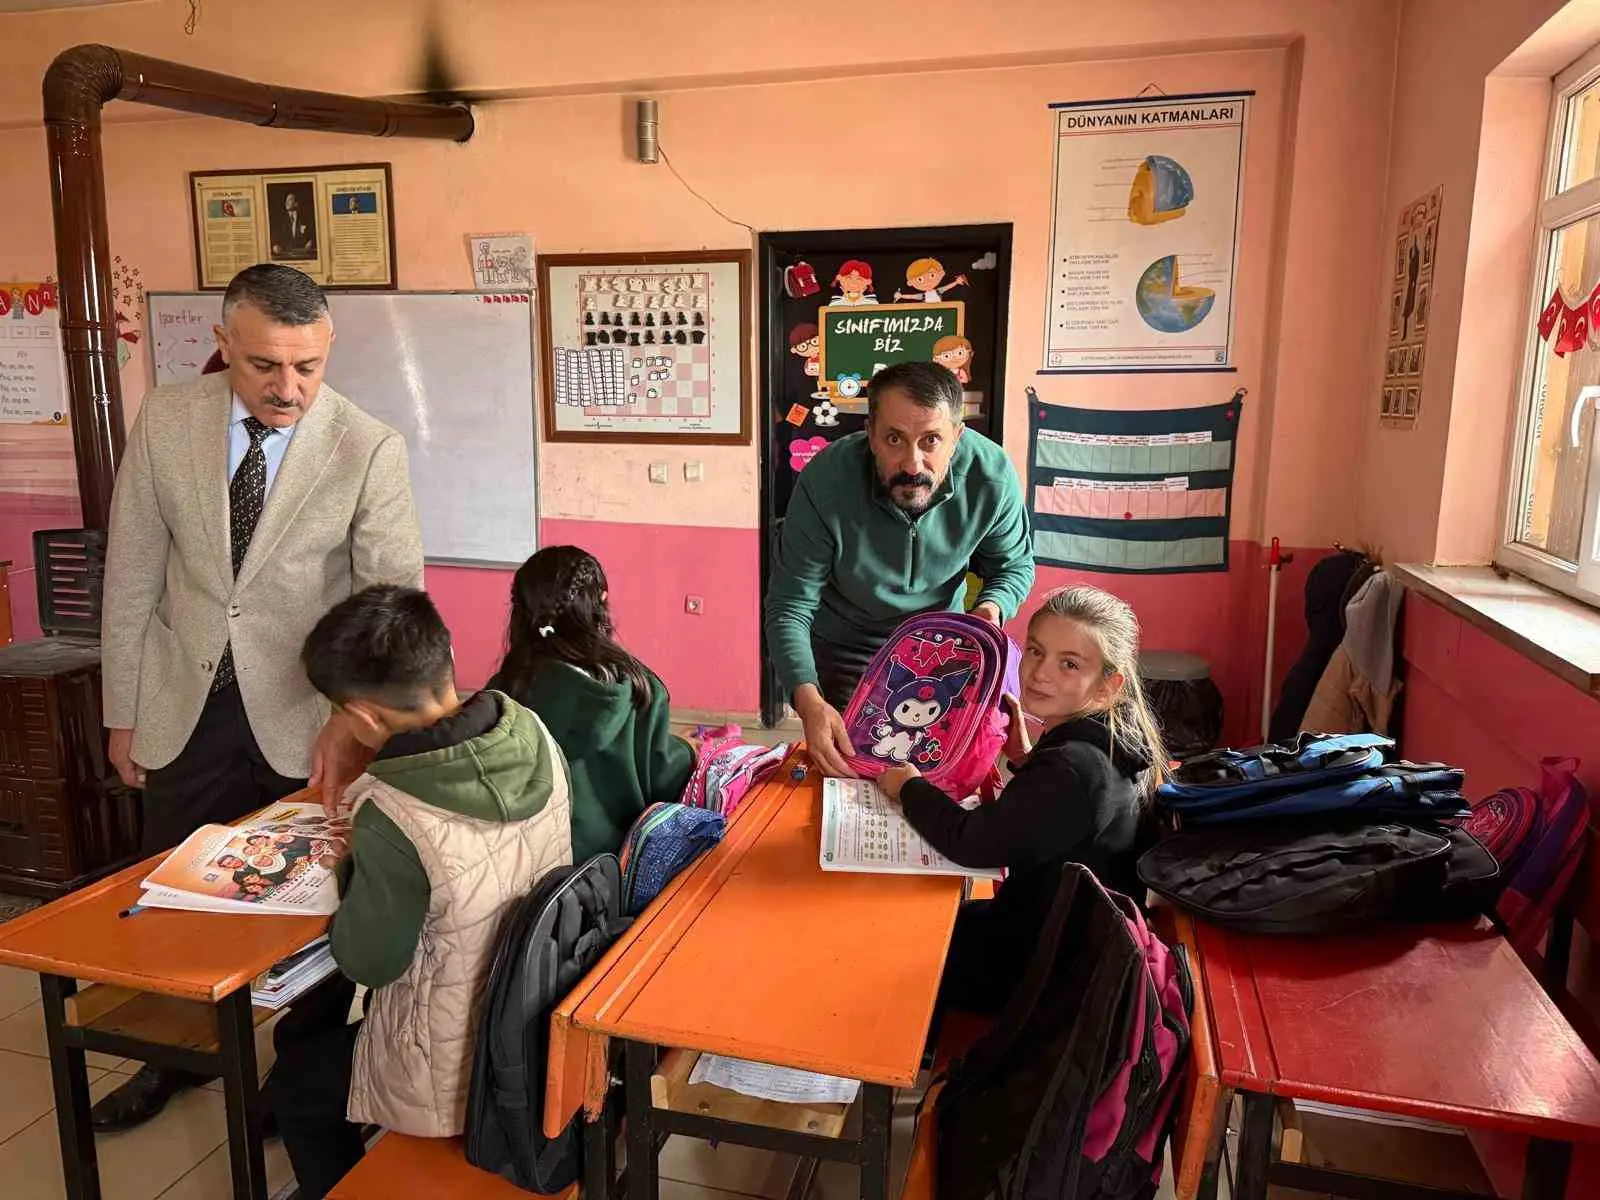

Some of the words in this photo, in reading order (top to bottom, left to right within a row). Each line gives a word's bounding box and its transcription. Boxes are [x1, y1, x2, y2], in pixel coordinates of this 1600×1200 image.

[1067, 112, 1137, 129] DÜNYANIN
[1141, 107, 1234, 124] KATMANLARI
[834, 316, 944, 334] SINIFIMIZDA
[873, 334, 904, 353] BİZ
